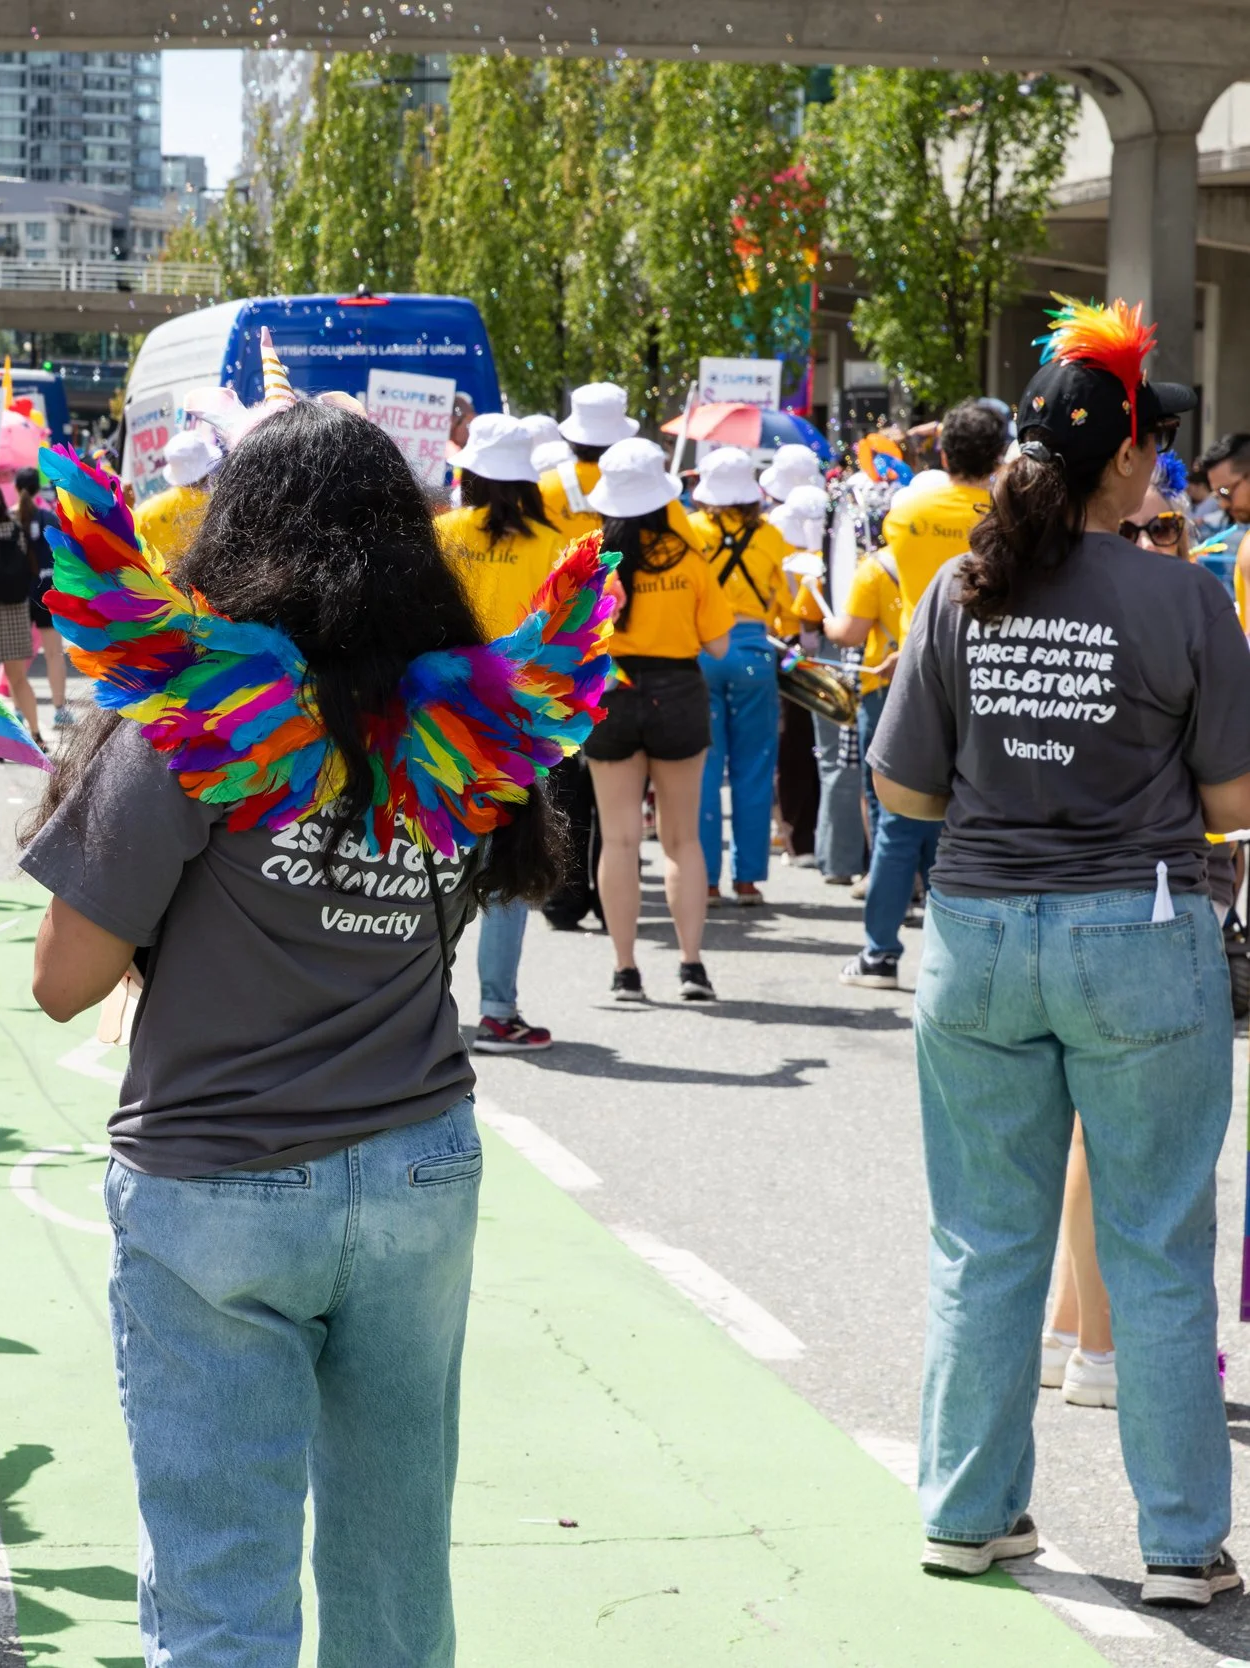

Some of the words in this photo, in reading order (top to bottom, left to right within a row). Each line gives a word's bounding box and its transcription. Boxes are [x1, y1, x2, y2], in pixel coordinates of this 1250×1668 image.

[379, 344, 427, 356] LARGEST
[430, 344, 466, 356] UNION
[933, 523, 963, 538] Sun
[490, 548, 518, 565] Life
[660, 574, 688, 592] Life
[966, 618, 980, 641] A
[983, 615, 1119, 647] FINANCIAL
[967, 643, 1028, 665] FORCE
[1030, 646, 1070, 667] FOR
[1074, 650, 1114, 671] THE
[1003, 738, 1075, 766] Vancity
[321, 906, 421, 942] Vancity
